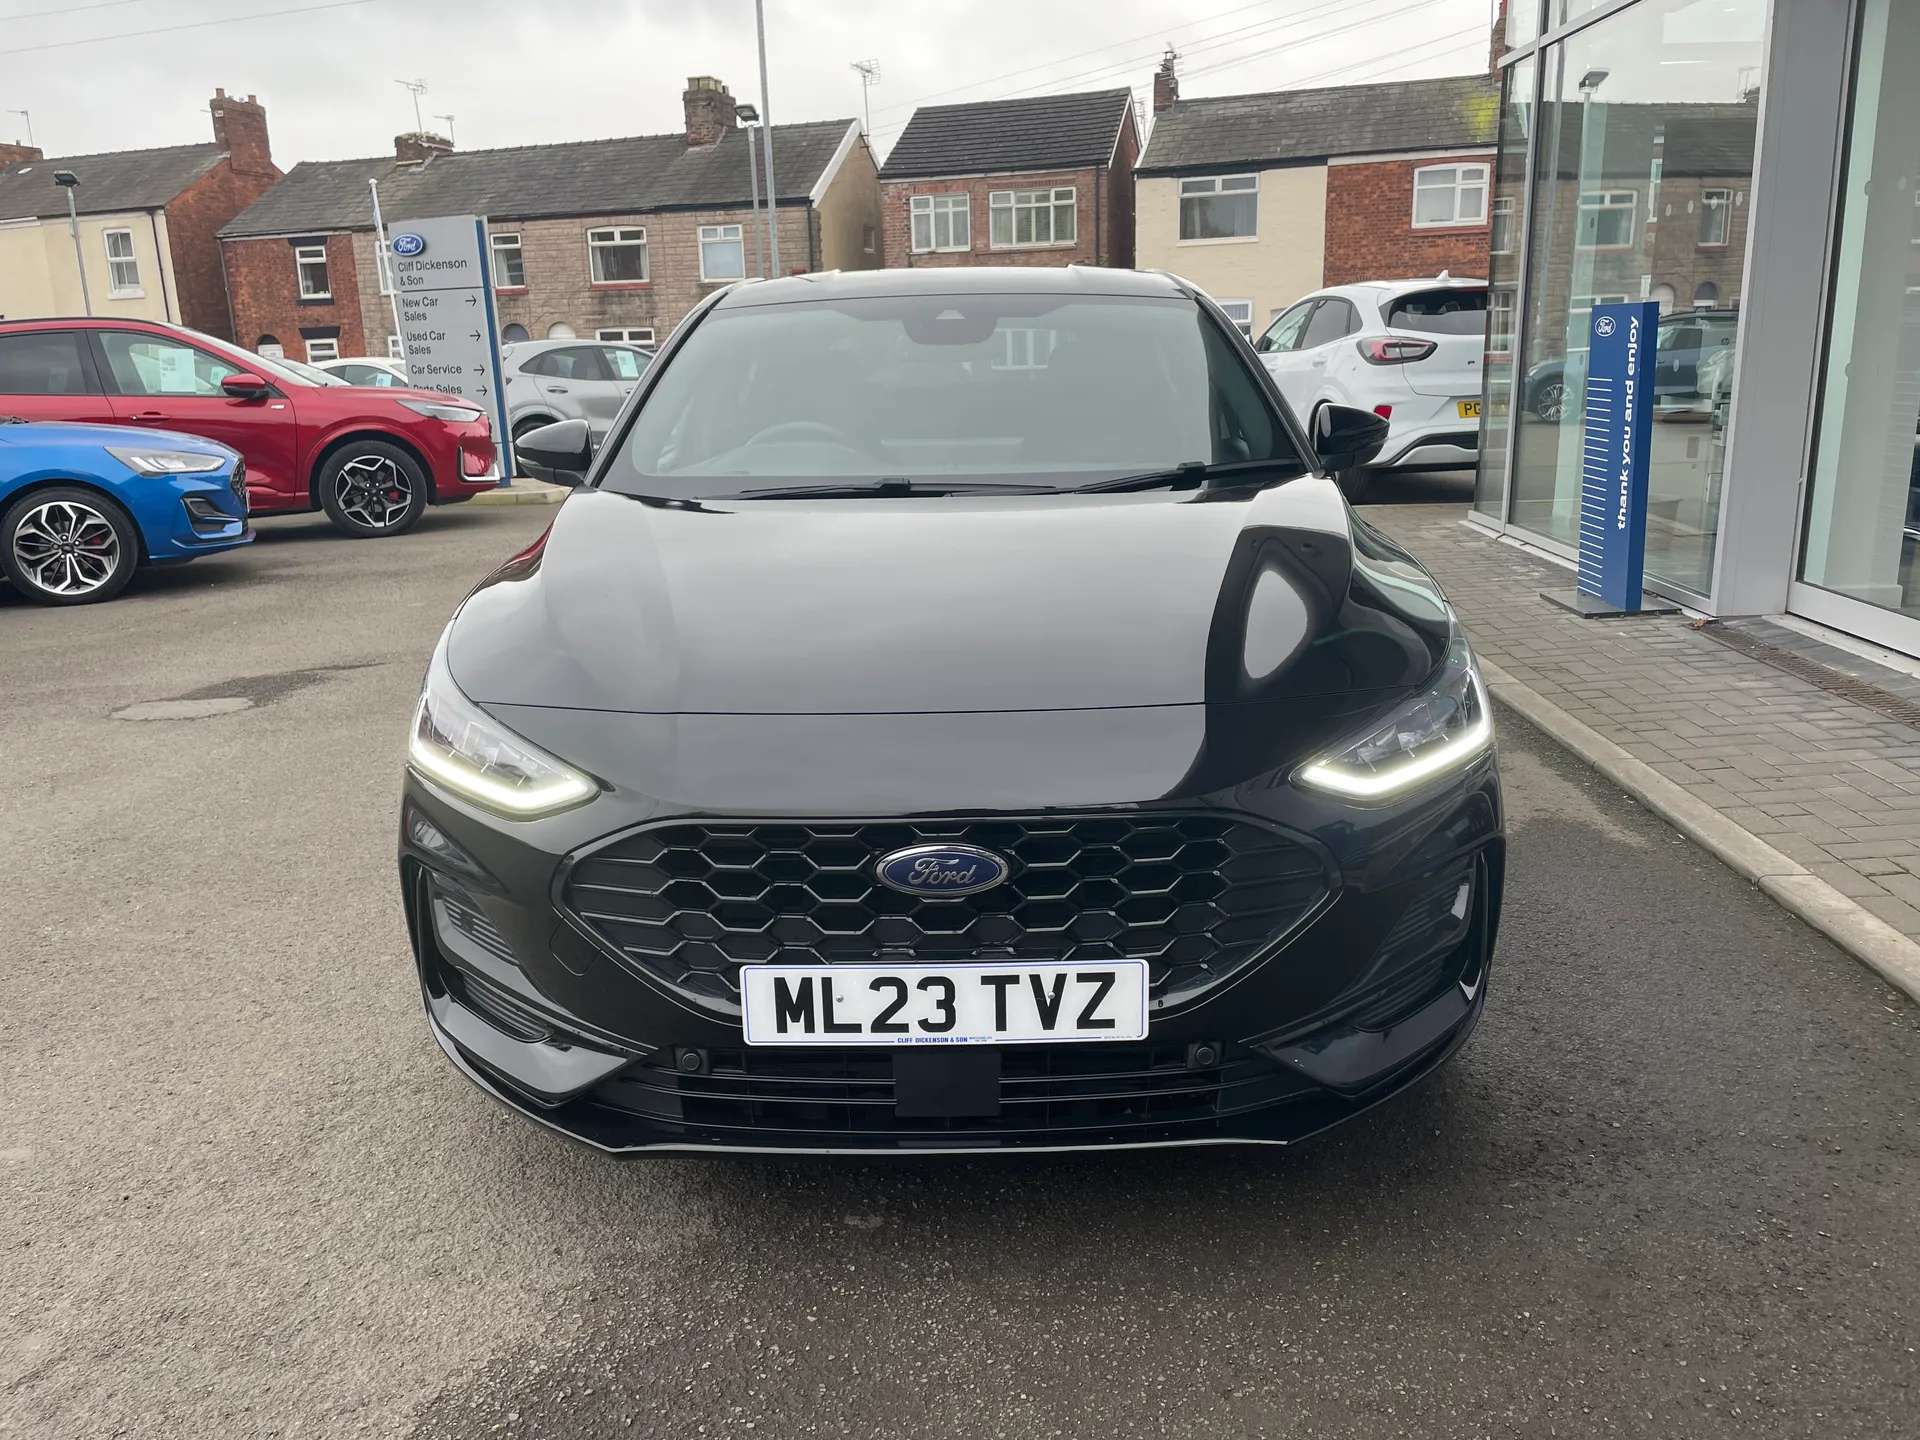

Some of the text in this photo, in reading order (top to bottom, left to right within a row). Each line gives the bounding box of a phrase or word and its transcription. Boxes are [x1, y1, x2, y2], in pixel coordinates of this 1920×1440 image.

[398, 259, 467, 272] Cliff Dickenson
[400, 275, 424, 286] & Son
[402, 296, 438, 308] New Car
[404, 311, 427, 321] Sales
[1598, 319, 1613, 333] Ford
[407, 330, 445, 341] Used Car
[408, 344, 431, 355] Sales
[411, 364, 462, 375] Car Service
[436, 384, 462, 394] Sales
[1617, 316, 1639, 530] thank you and enjoy
[908, 857, 977, 885] Ford
[773, 972, 1116, 1034] ML23 TVZ
